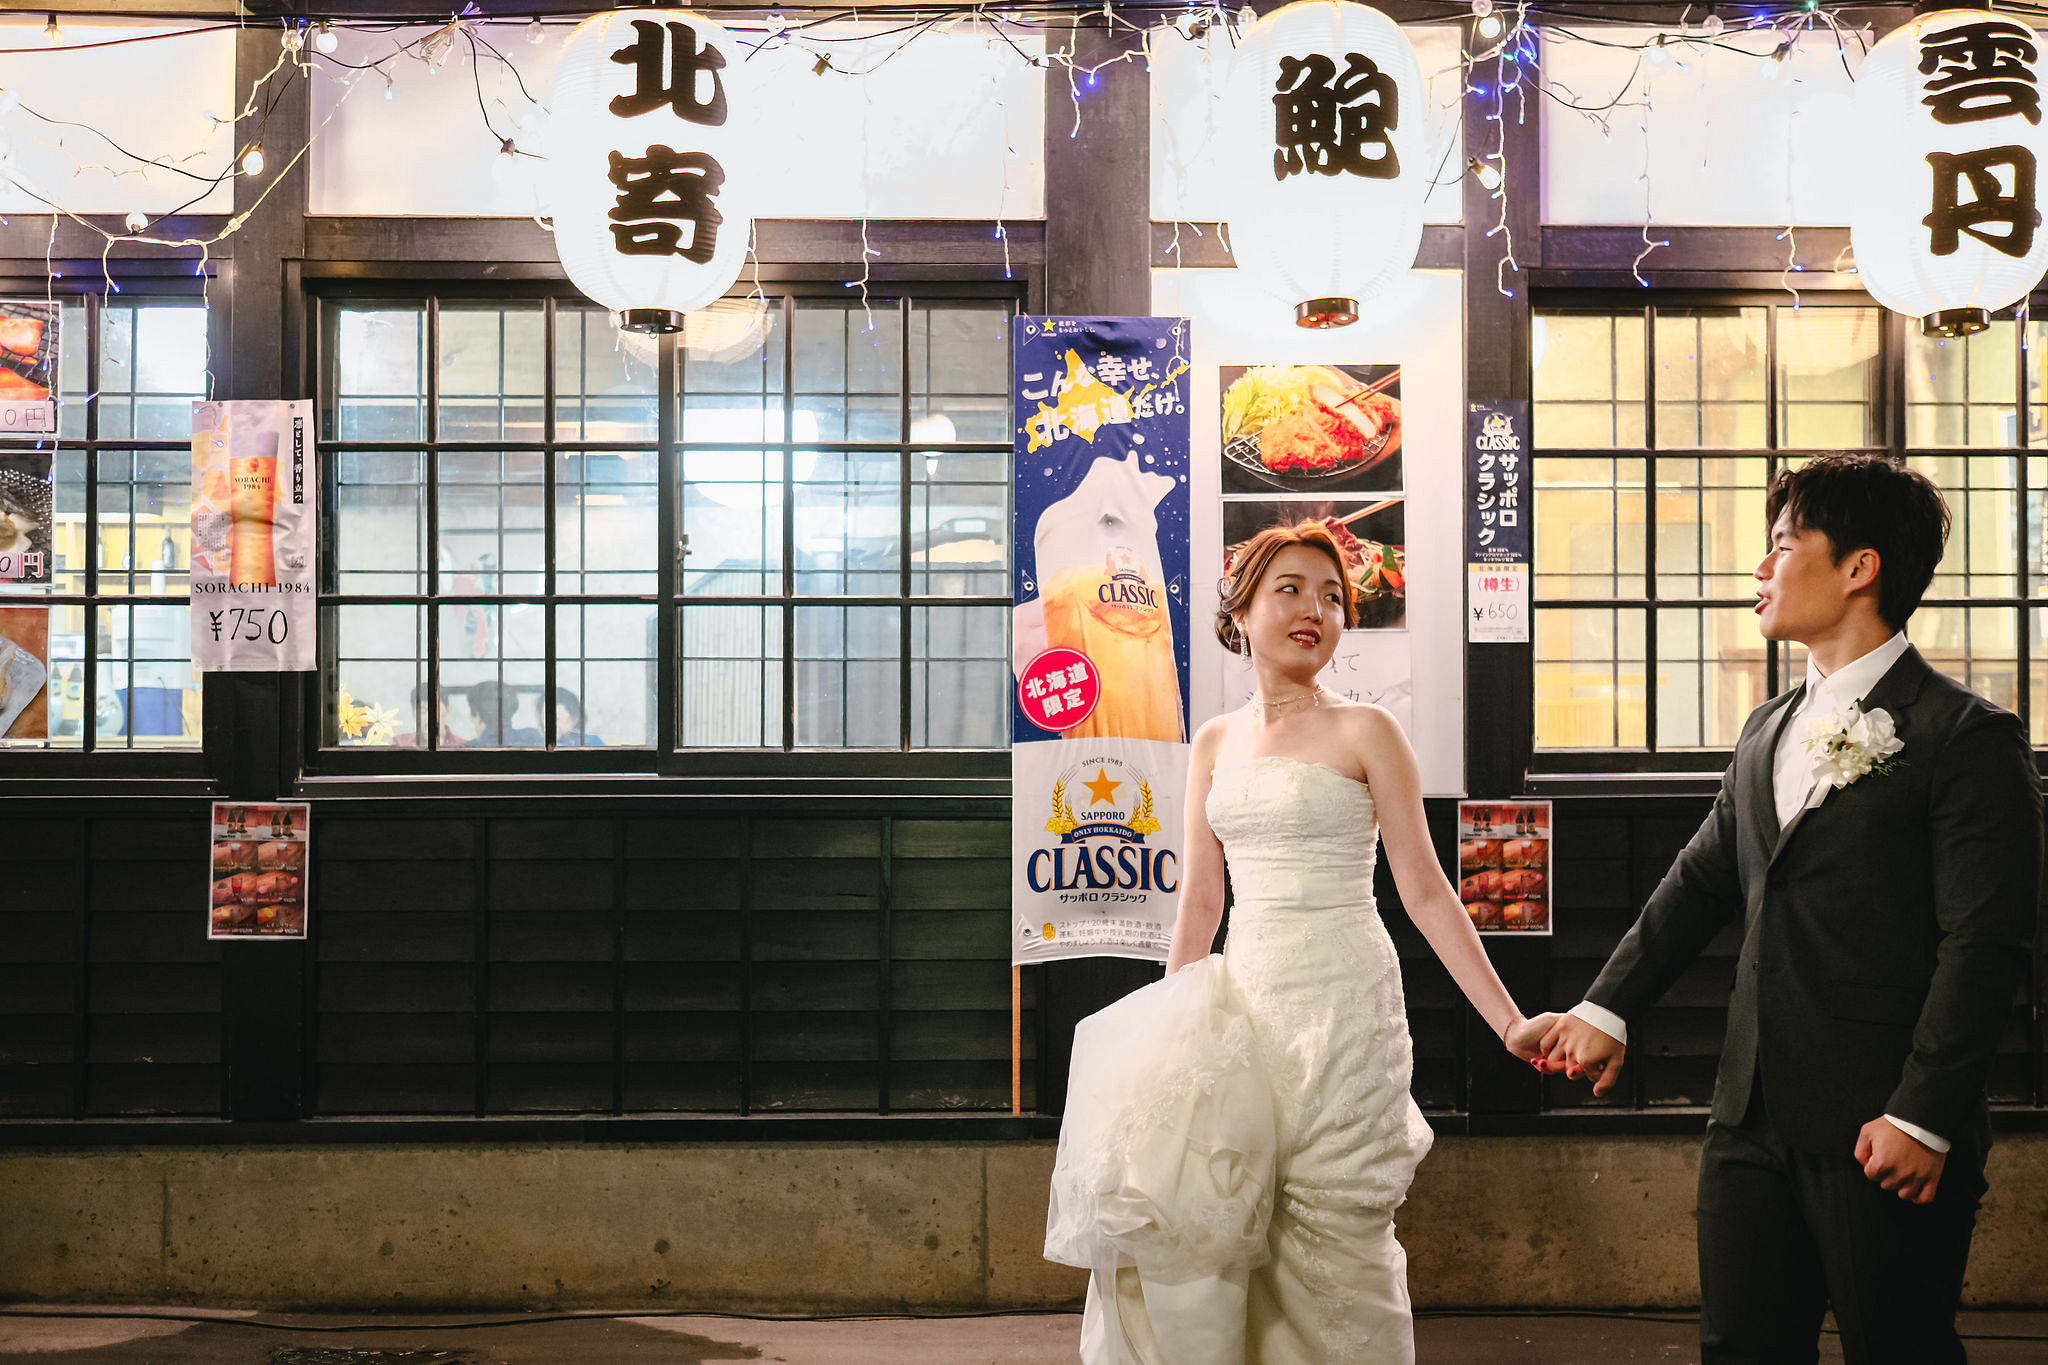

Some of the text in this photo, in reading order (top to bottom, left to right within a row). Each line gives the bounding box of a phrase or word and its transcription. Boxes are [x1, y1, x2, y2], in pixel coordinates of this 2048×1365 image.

[1272, 52, 1401, 181] 鮑
[608, 19, 728, 265] 北寄
[1917, 21, 2042, 259] 雲丹
[1021, 354, 1160, 400] こんな幸せ、
[1034, 391, 1186, 444] 北海道だけ。
[1475, 435, 1521, 451] CLASSIC
[1477, 453, 1496, 546] クラシック
[1498, 453, 1519, 527] サッポロ
[195, 581, 311, 594] SORACHI 1984
[1098, 583, 1159, 609] CLASSIC
[1025, 661, 1089, 699] 北海道
[1041, 687, 1086, 719] 限定
[1082, 757, 1105, 767] SINCE
[1073, 826, 1133, 838] ONLY HOKKAIDO
[1080, 811, 1126, 821] SAPPORO
[1027, 845, 1178, 893] CLASSIC
[1059, 892, 1147, 903] サッポロ クラシック
